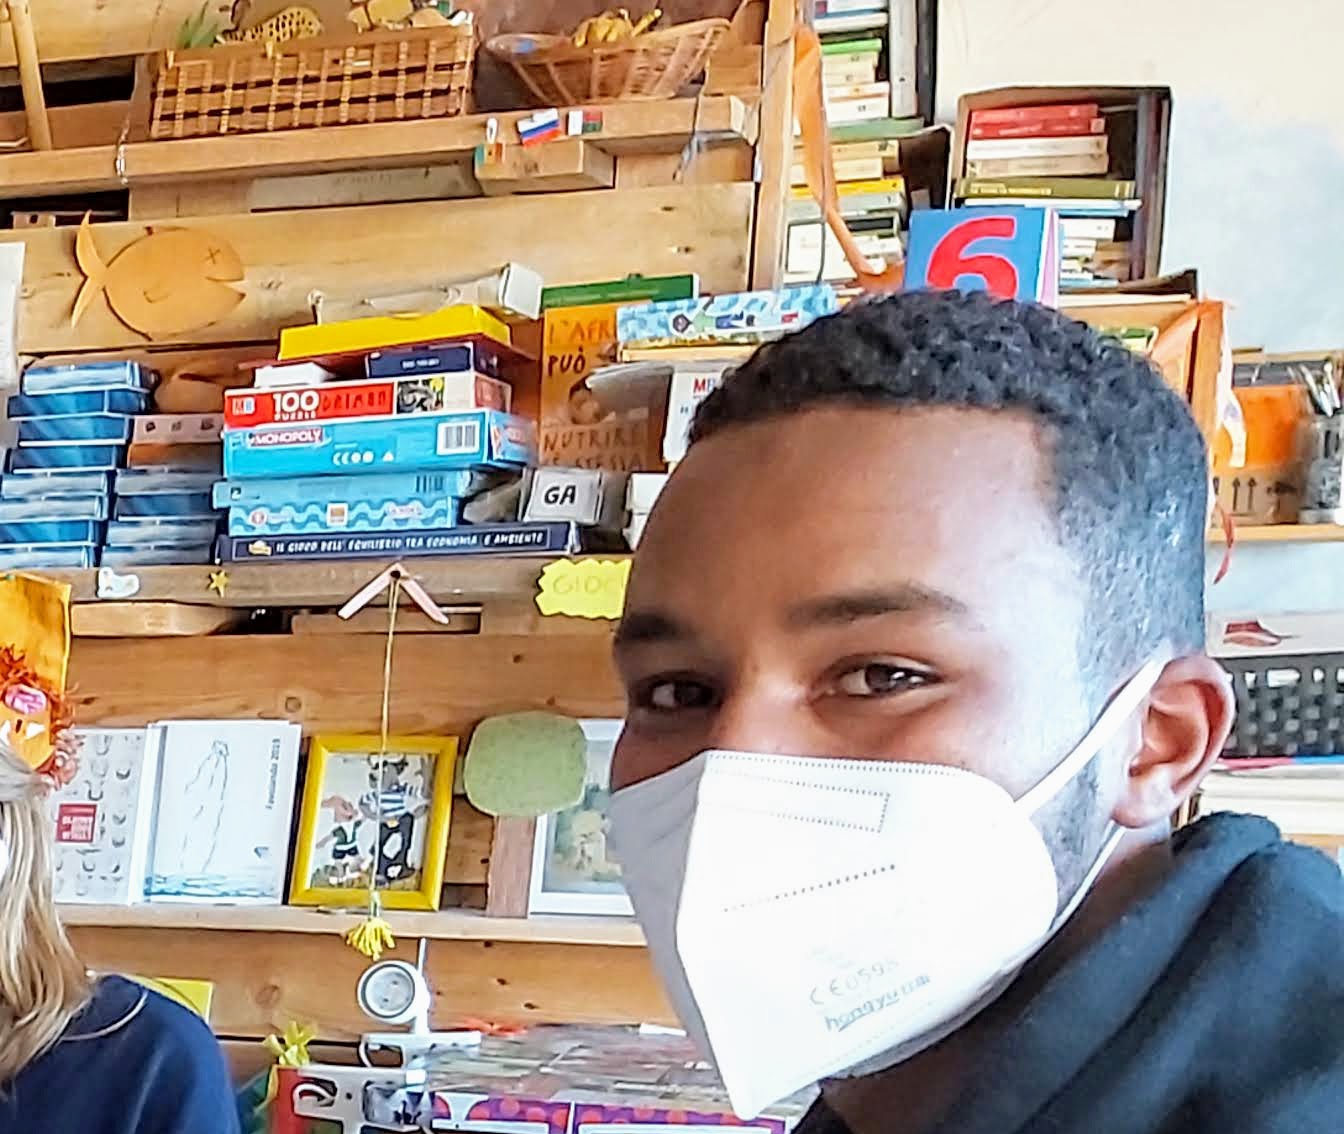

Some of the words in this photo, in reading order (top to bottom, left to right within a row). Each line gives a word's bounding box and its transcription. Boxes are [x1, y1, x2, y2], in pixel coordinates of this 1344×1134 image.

[927, 215, 1018, 304] 6
[548, 348, 586, 376] PUÒ
[272, 390, 320, 413] 100
[254, 430, 322, 446] MONOPOLY
[544, 484, 576, 505] GA
[276, 542, 283, 553] IL
[286, 540, 314, 553] GIOCO
[348, 536, 402, 552] EQUILIBRIO
[405, 536, 424, 549] TRA
[426, 534, 478, 550] ECONOMIA
[493, 531, 543, 546] AMBIENTE
